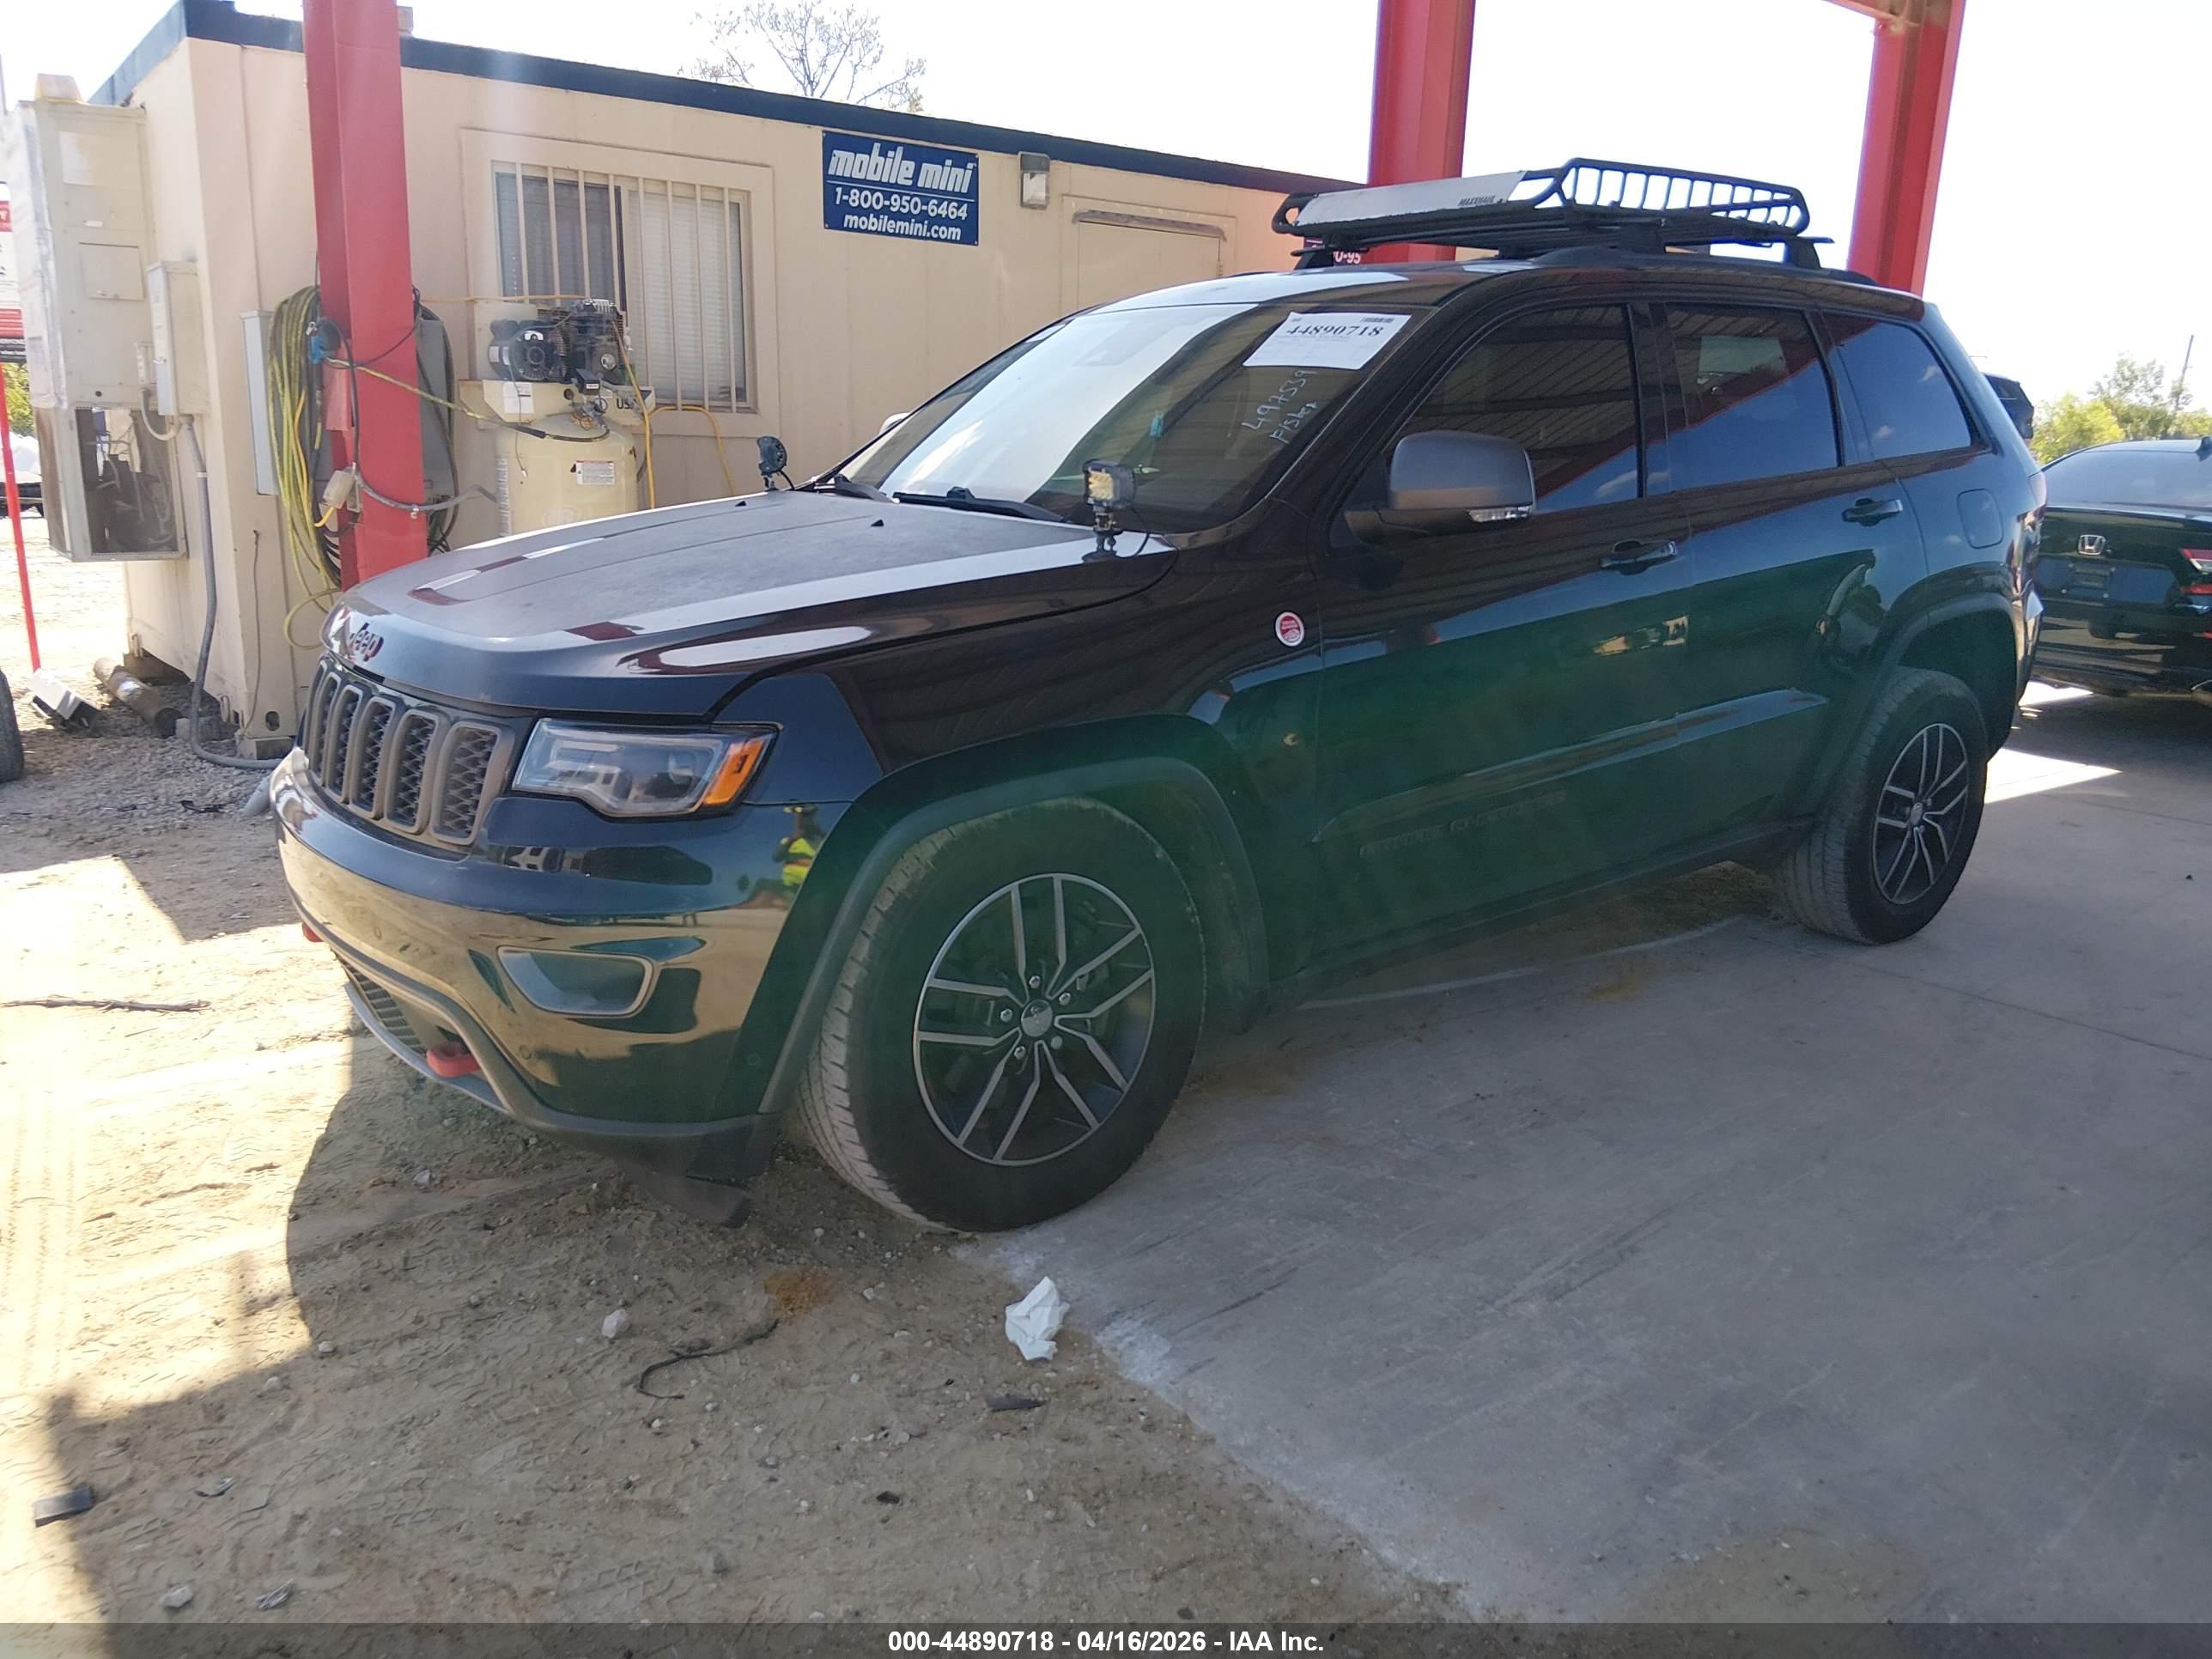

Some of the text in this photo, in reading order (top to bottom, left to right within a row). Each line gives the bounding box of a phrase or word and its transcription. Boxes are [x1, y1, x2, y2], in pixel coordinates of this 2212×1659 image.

[828, 143, 973, 193] mobile mini
[835, 186, 969, 221] 1-800-950-6464
[843, 214, 962, 240] mobilemini.com
[1286, 324, 1384, 337] 44890718
